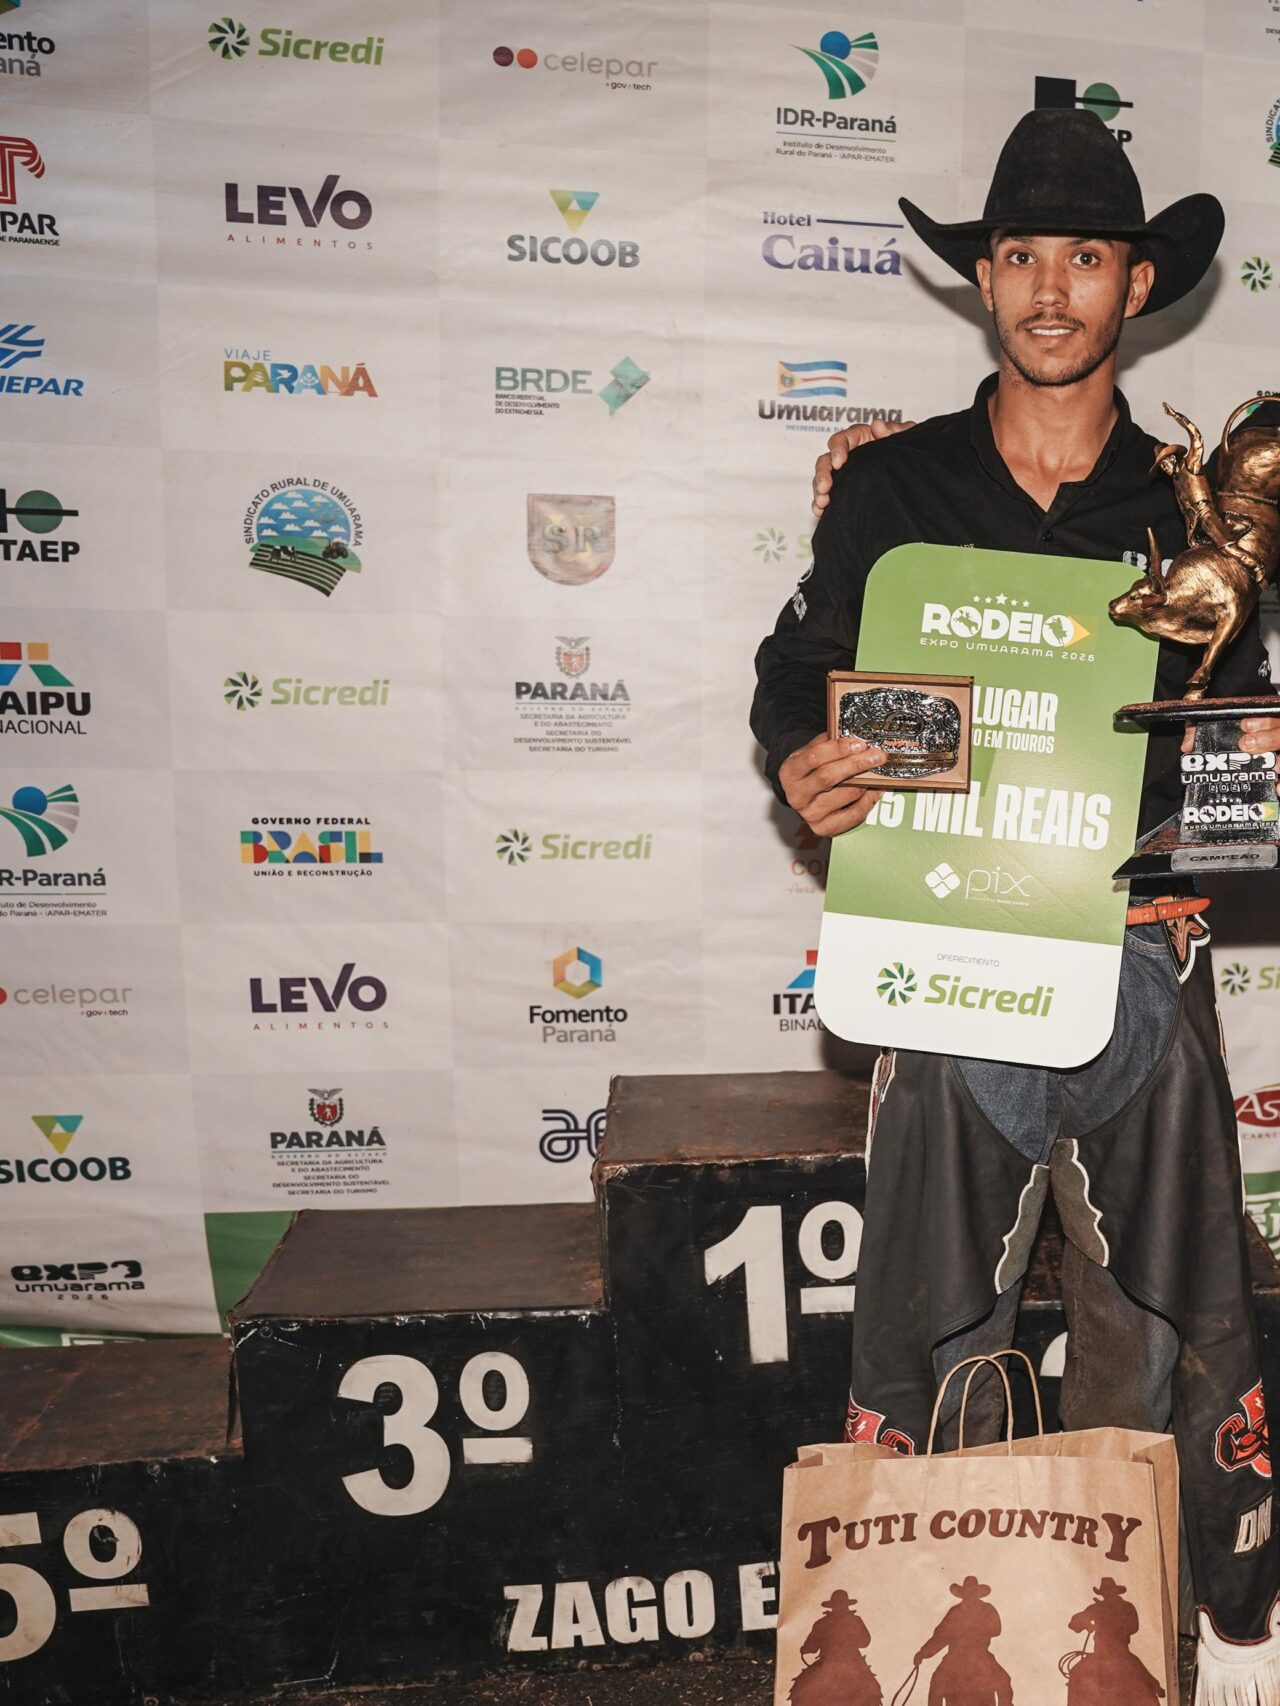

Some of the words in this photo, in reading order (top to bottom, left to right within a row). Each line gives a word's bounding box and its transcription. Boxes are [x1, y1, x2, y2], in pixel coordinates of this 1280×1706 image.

[258, 27, 385, 66] Sicredi
[543, 49, 658, 80] celepar
[776, 107, 896, 133] IDR-Paraná
[225, 174, 373, 230] LEVO
[763, 211, 812, 228] Hotel
[9, 236, 60, 246] PARANAENSE
[227, 233, 374, 250] ALIMENTOS
[506, 234, 640, 268] SICOOB
[762, 234, 903, 276] Caiuá
[224, 348, 272, 361] VIAJE
[224, 361, 378, 397] PARANÁ
[495, 366, 593, 394] BRDE
[758, 399, 903, 424] Umuarama
[243, 489, 271, 545] SINDICATO
[270, 477, 311, 493] RURAL
[312, 478, 330, 491] DE
[330, 486, 363, 547] UMUARAMA
[921, 602, 1075, 648] RODEIO
[919, 637, 959, 649] EXPO
[966, 642, 1054, 658] UMUARAMA
[1062, 651, 1095, 662] 2026
[271, 677, 390, 707] Sicredi
[515, 679, 631, 701] PARANÁ
[972, 685, 1059, 732] LUGAR
[0, 719, 87, 734] ACIONAL
[984, 730, 1003, 749] EM
[1006, 731, 1055, 754] TOUROS
[1209, 783, 1251, 793] 2026
[251, 817, 311, 825] GOVERNO
[316, 817, 371, 825] FEDERAL
[912, 781, 983, 838] MIL
[992, 783, 1112, 850] REAIS
[1184, 803, 1264, 824] RODEIO
[240, 830, 384, 864] BRASIL
[540, 833, 653, 860] Sicredi
[965, 866, 1033, 900] pix
[937, 953, 1000, 967] OFERECIMENTO
[14, 984, 132, 1007] celepar
[250, 963, 387, 1013] LEVO
[924, 974, 1055, 1018] Sicredi
[253, 1021, 389, 1031] ALIMENTOS
[529, 1005, 628, 1025] Fomento
[542, 1023, 616, 1043] Paraná
[270, 1126, 386, 1149] PARANÁ
[797, 1512, 918, 1569] TUTI
[930, 1508, 1142, 1563] COUNTRY
[503, 1569, 716, 1653] ZAGO
